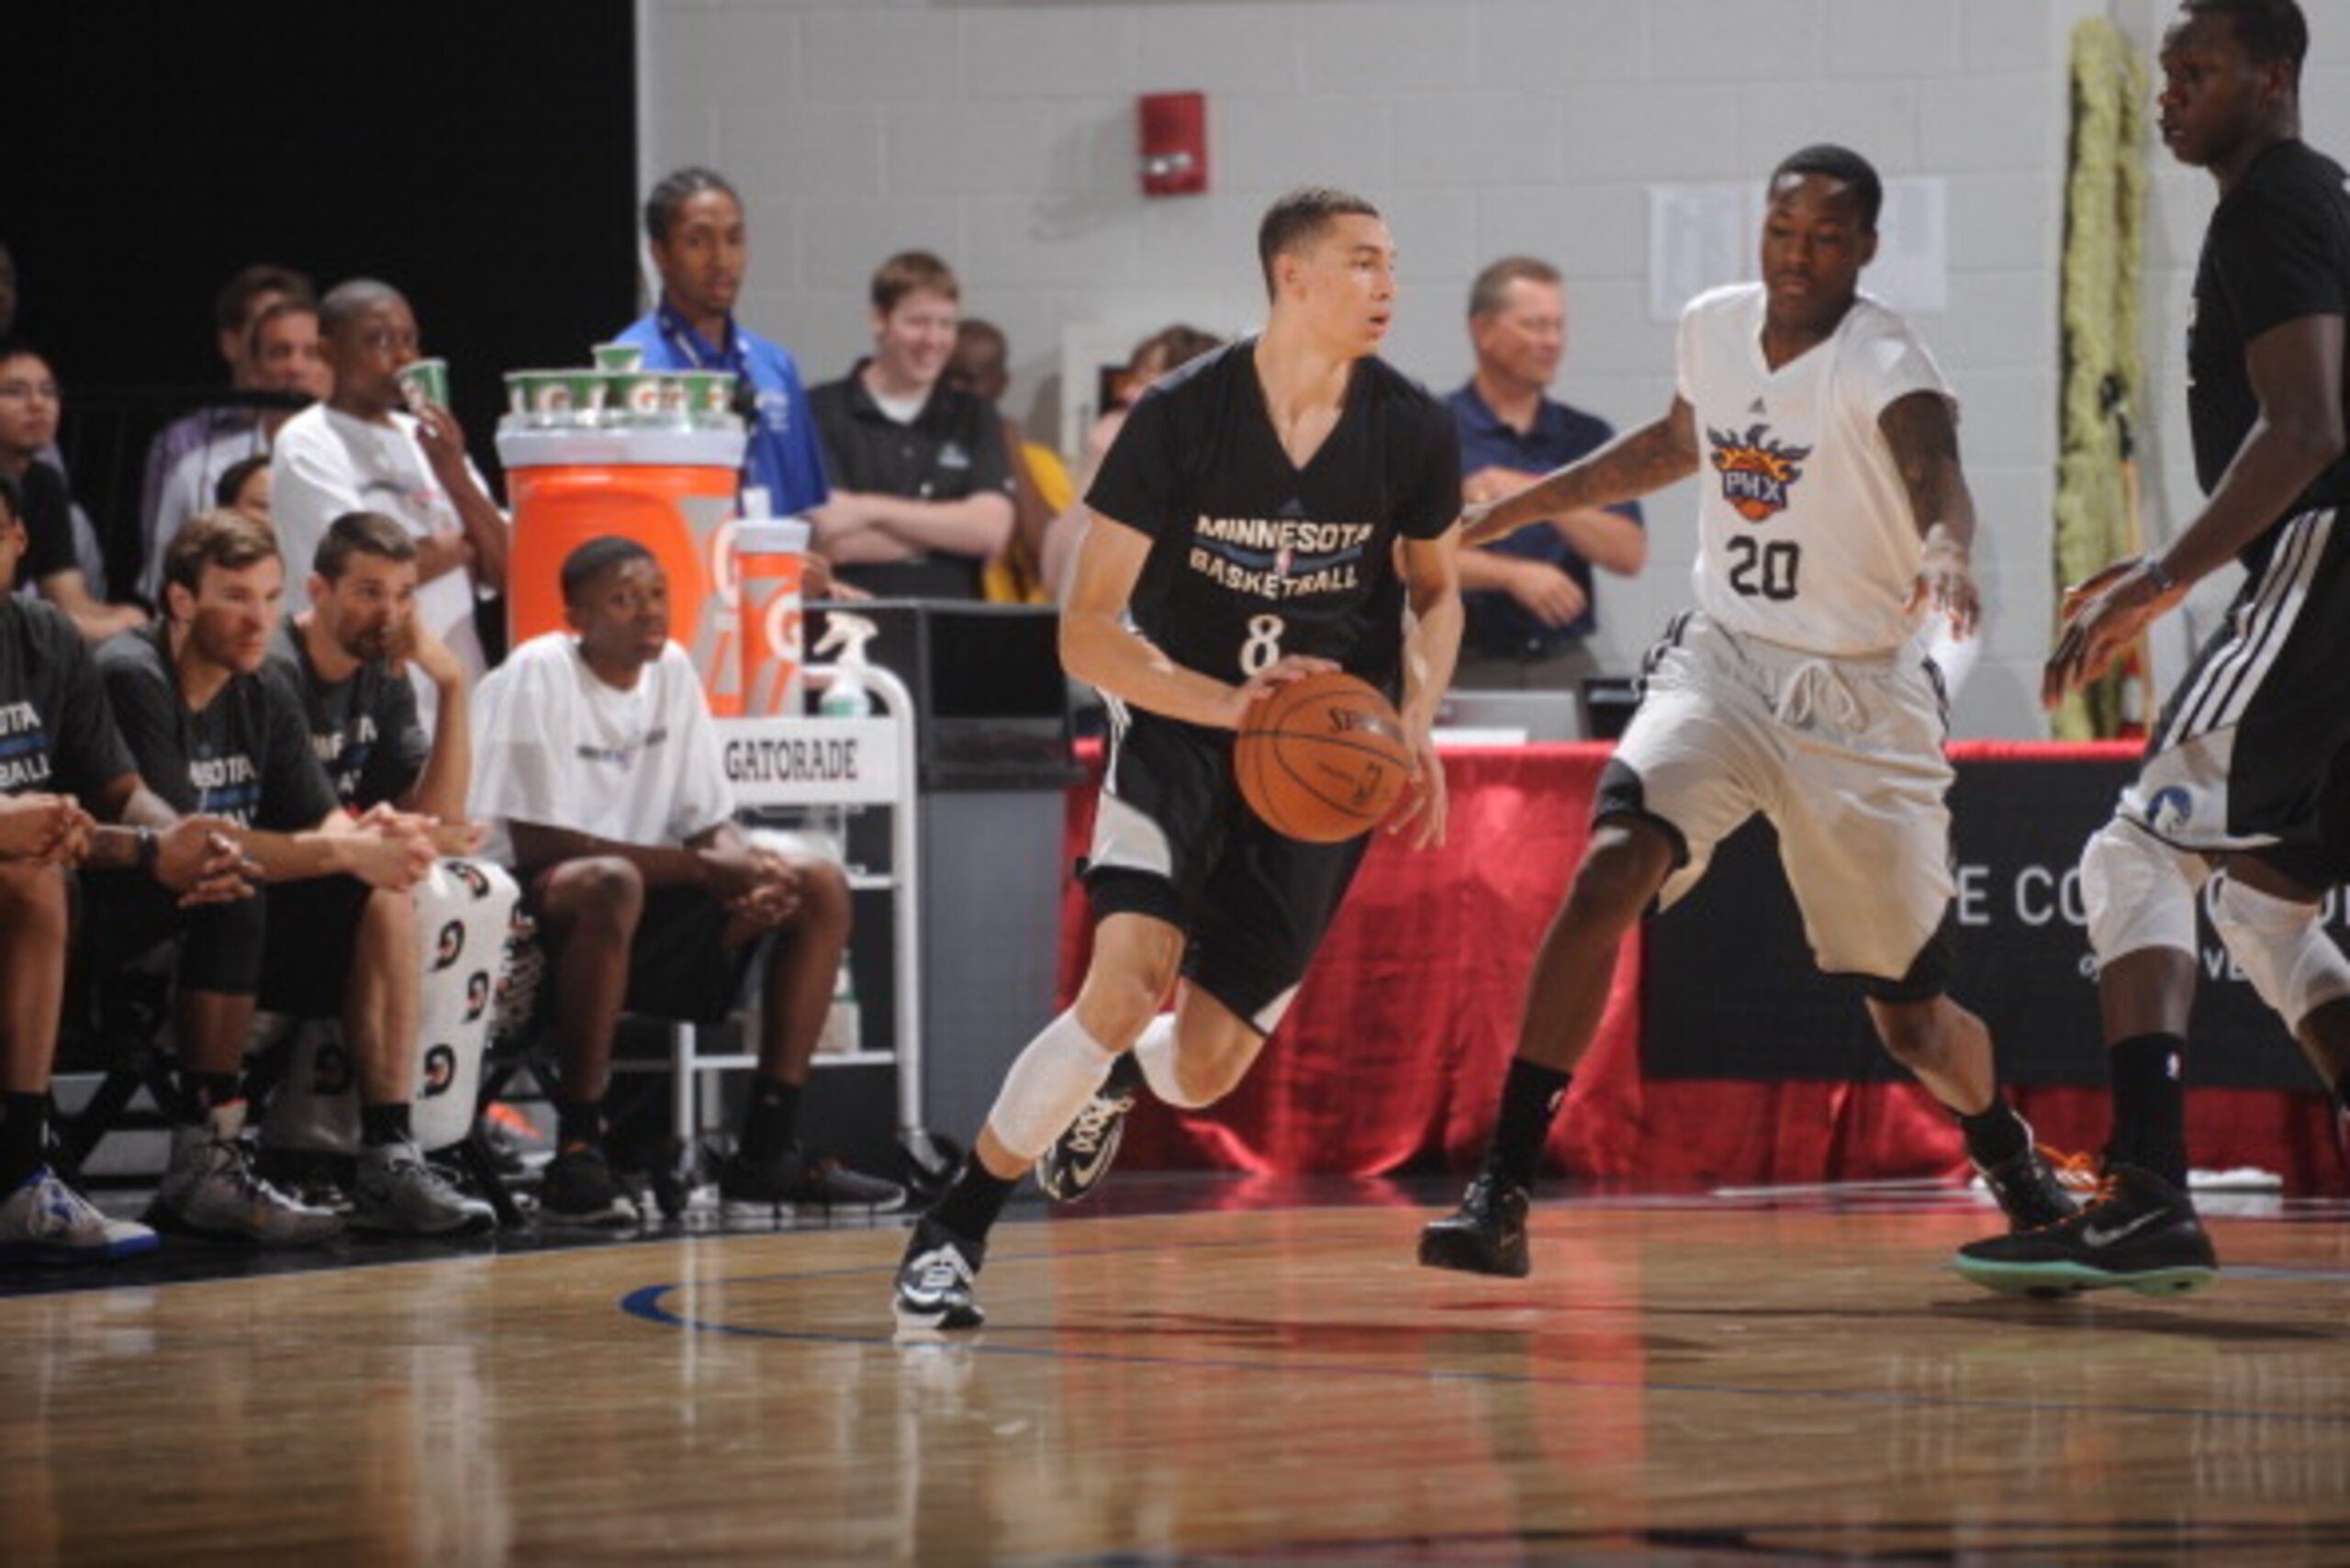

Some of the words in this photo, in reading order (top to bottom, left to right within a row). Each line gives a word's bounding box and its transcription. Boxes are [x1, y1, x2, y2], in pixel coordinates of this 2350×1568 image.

[1726, 470, 1782, 502] PHX
[1190, 547, 1359, 599] BASKETBALL
[1726, 535, 1801, 600] 20
[1241, 613, 1286, 678] 8
[724, 738, 858, 781] GATORADE
